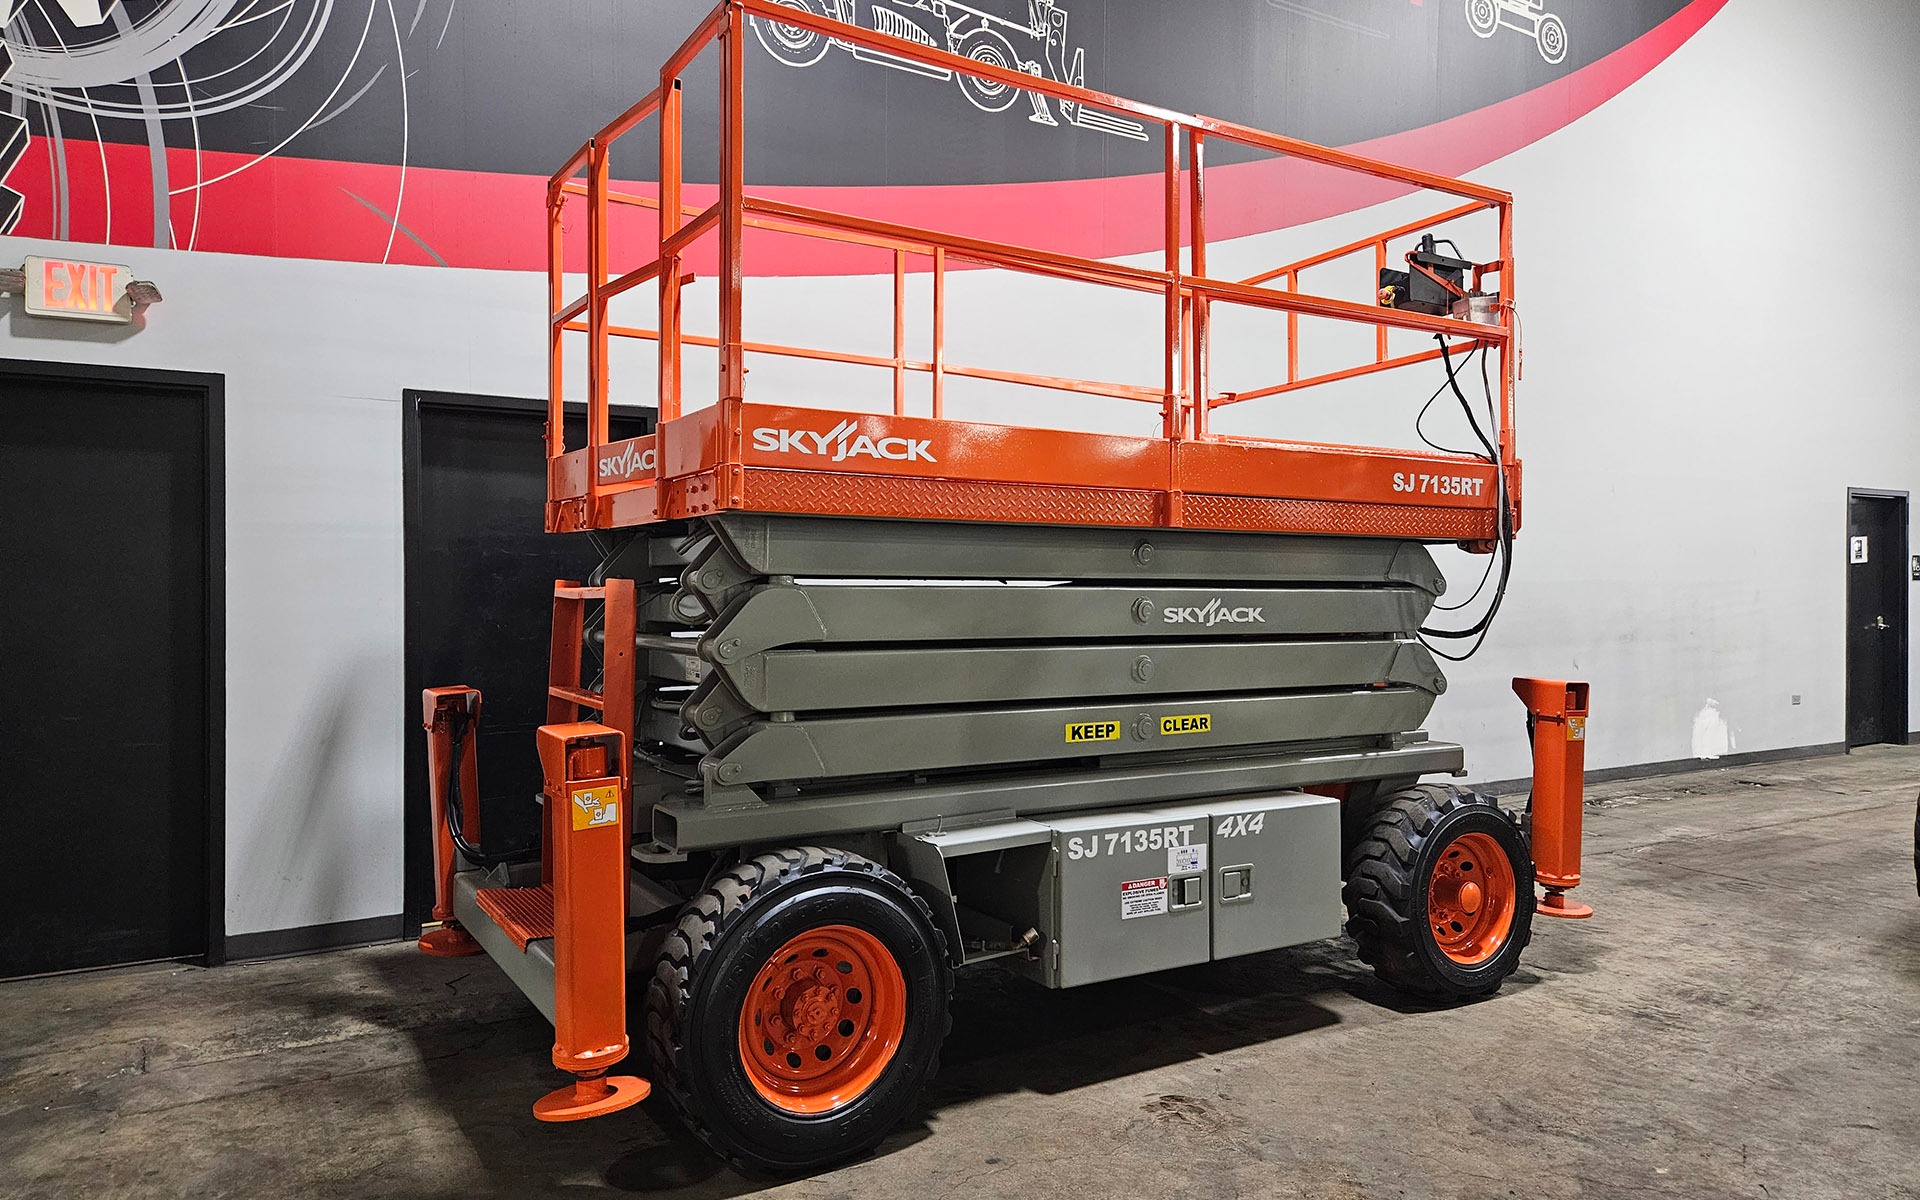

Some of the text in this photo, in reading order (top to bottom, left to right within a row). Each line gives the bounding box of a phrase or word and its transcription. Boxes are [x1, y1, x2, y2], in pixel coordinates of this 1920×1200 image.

[44, 260, 118, 313] EXIT
[752, 419, 937, 463] SKYJACK
[599, 441, 656, 479] SKYJAC
[1392, 472, 1484, 496] SJ 7135RT
[1163, 598, 1266, 627] SKYJACK
[1071, 716, 1209, 740] KEEP CLEAR
[1216, 812, 1266, 838] 4X4
[1068, 825, 1194, 860] SJ 7135RT
[1132, 880, 1156, 889] DANGER
